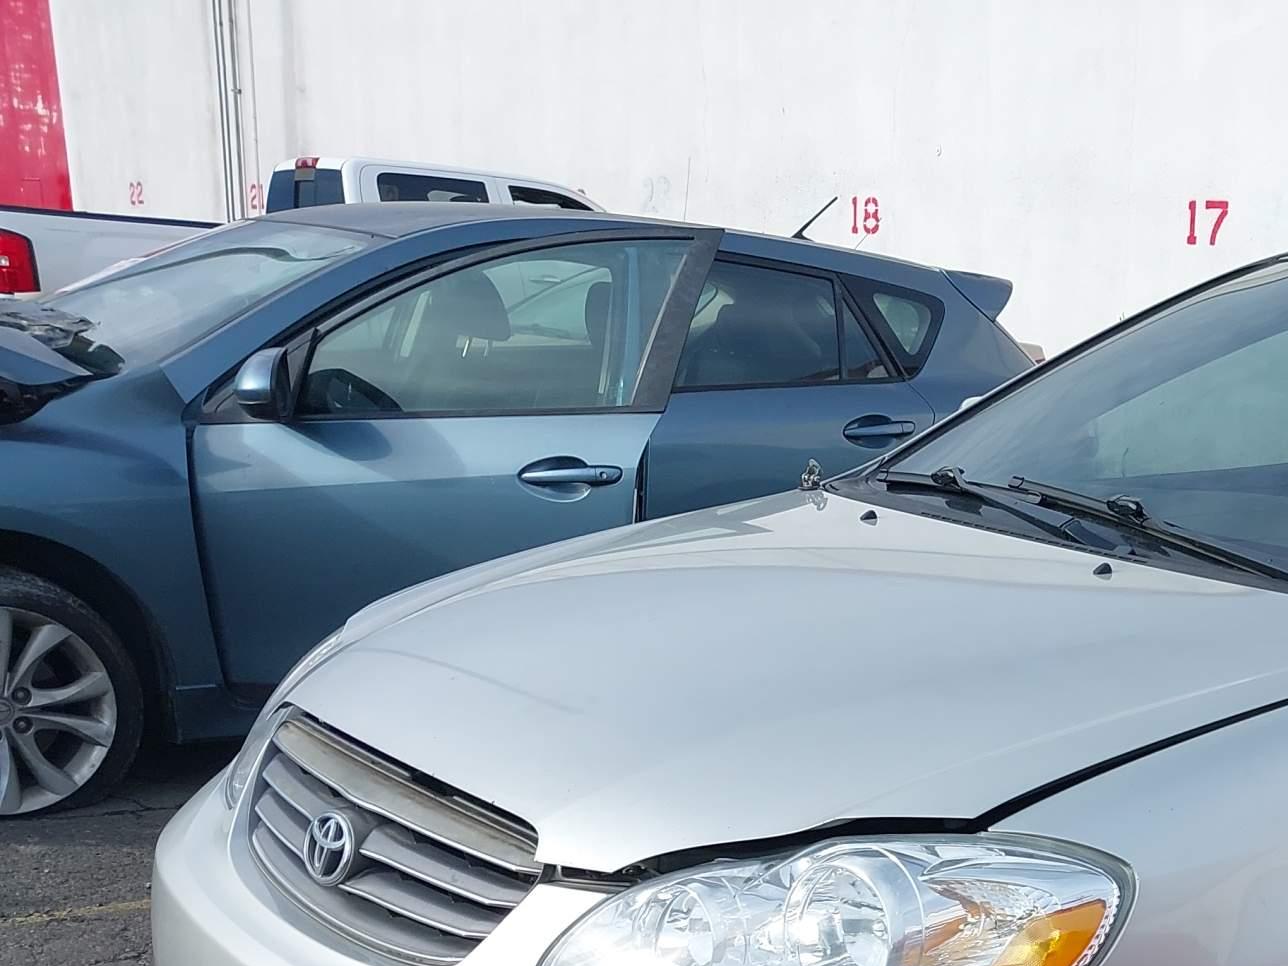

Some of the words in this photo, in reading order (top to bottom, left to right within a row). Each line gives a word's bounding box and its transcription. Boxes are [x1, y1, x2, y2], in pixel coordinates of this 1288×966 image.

[129, 182, 144, 206] 22
[250, 184, 264, 209] 21
[851, 197, 880, 235] 18
[1187, 200, 1229, 245] 17
